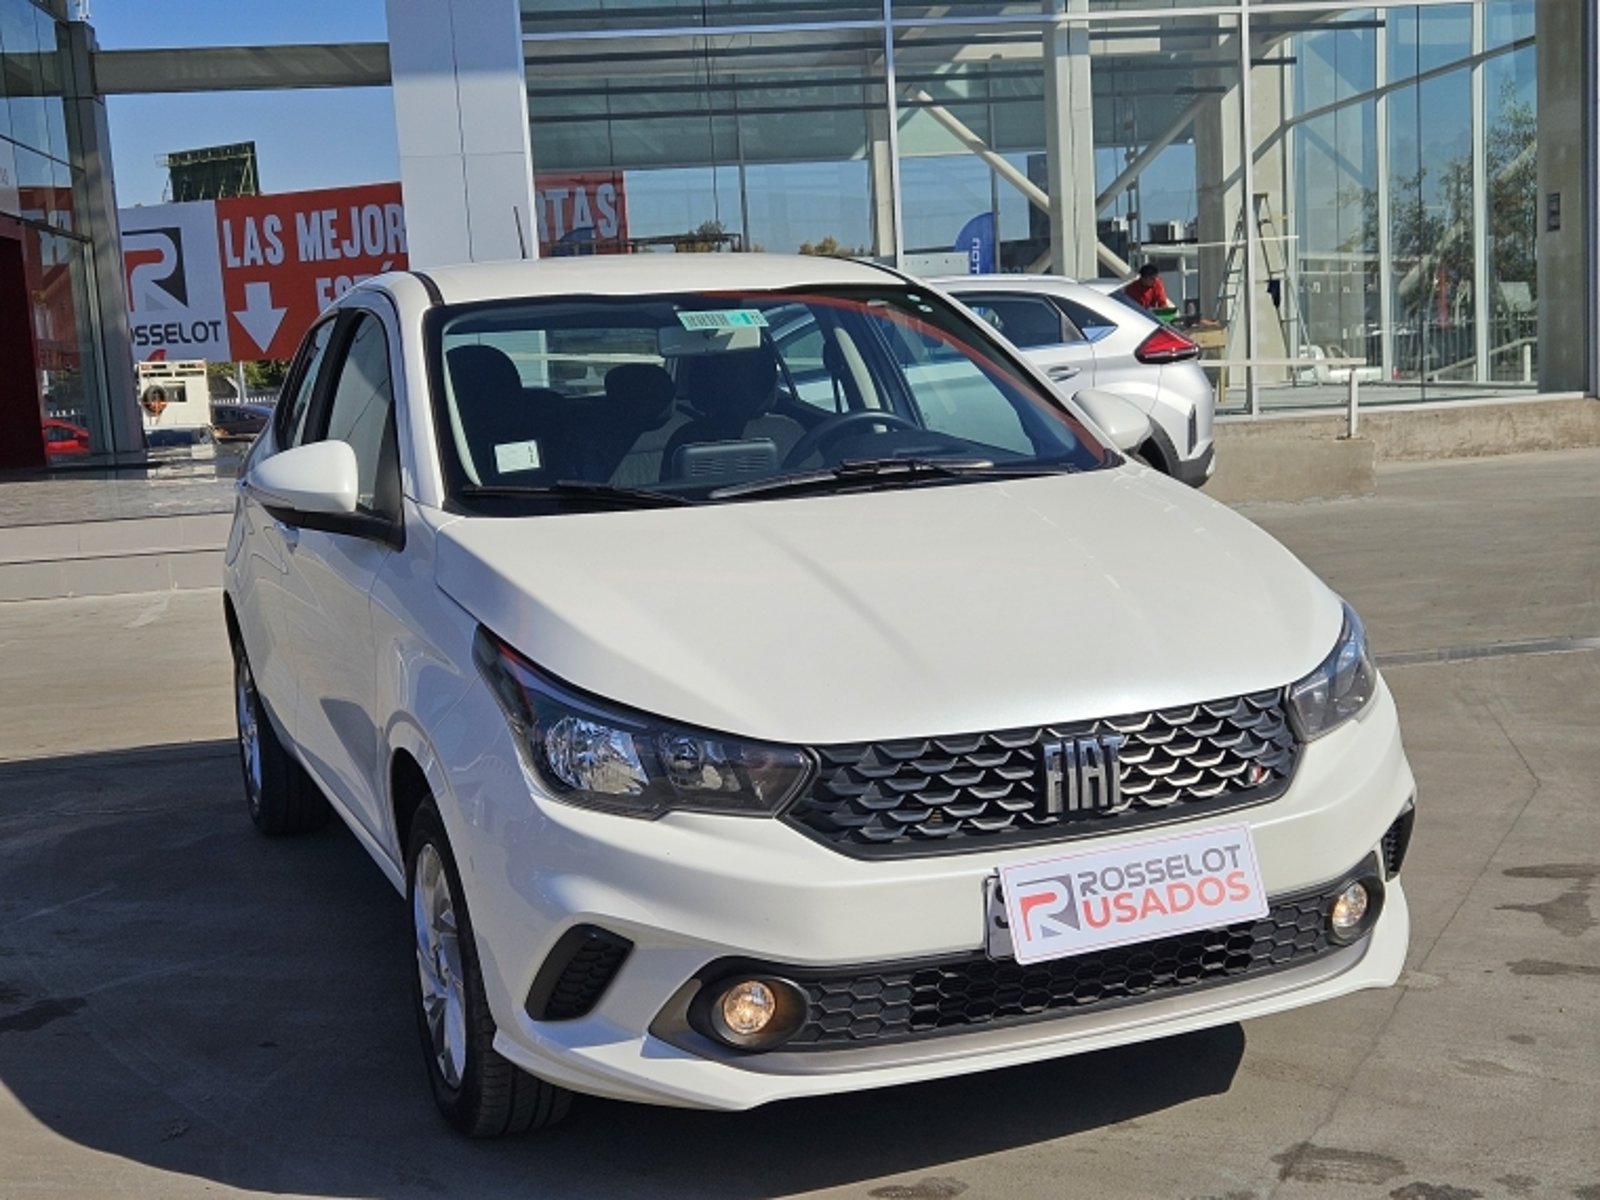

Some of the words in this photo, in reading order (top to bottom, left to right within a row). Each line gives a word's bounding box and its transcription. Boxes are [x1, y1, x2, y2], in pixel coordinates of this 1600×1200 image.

[222, 214, 285, 268] LAS
[295, 203, 409, 262] MEJOR
[130, 321, 222, 346] SSELOT
[1043, 735, 1125, 813] FIAT
[1077, 844, 1241, 897] ROSSELOT
[1082, 871, 1250, 929] USADOS
